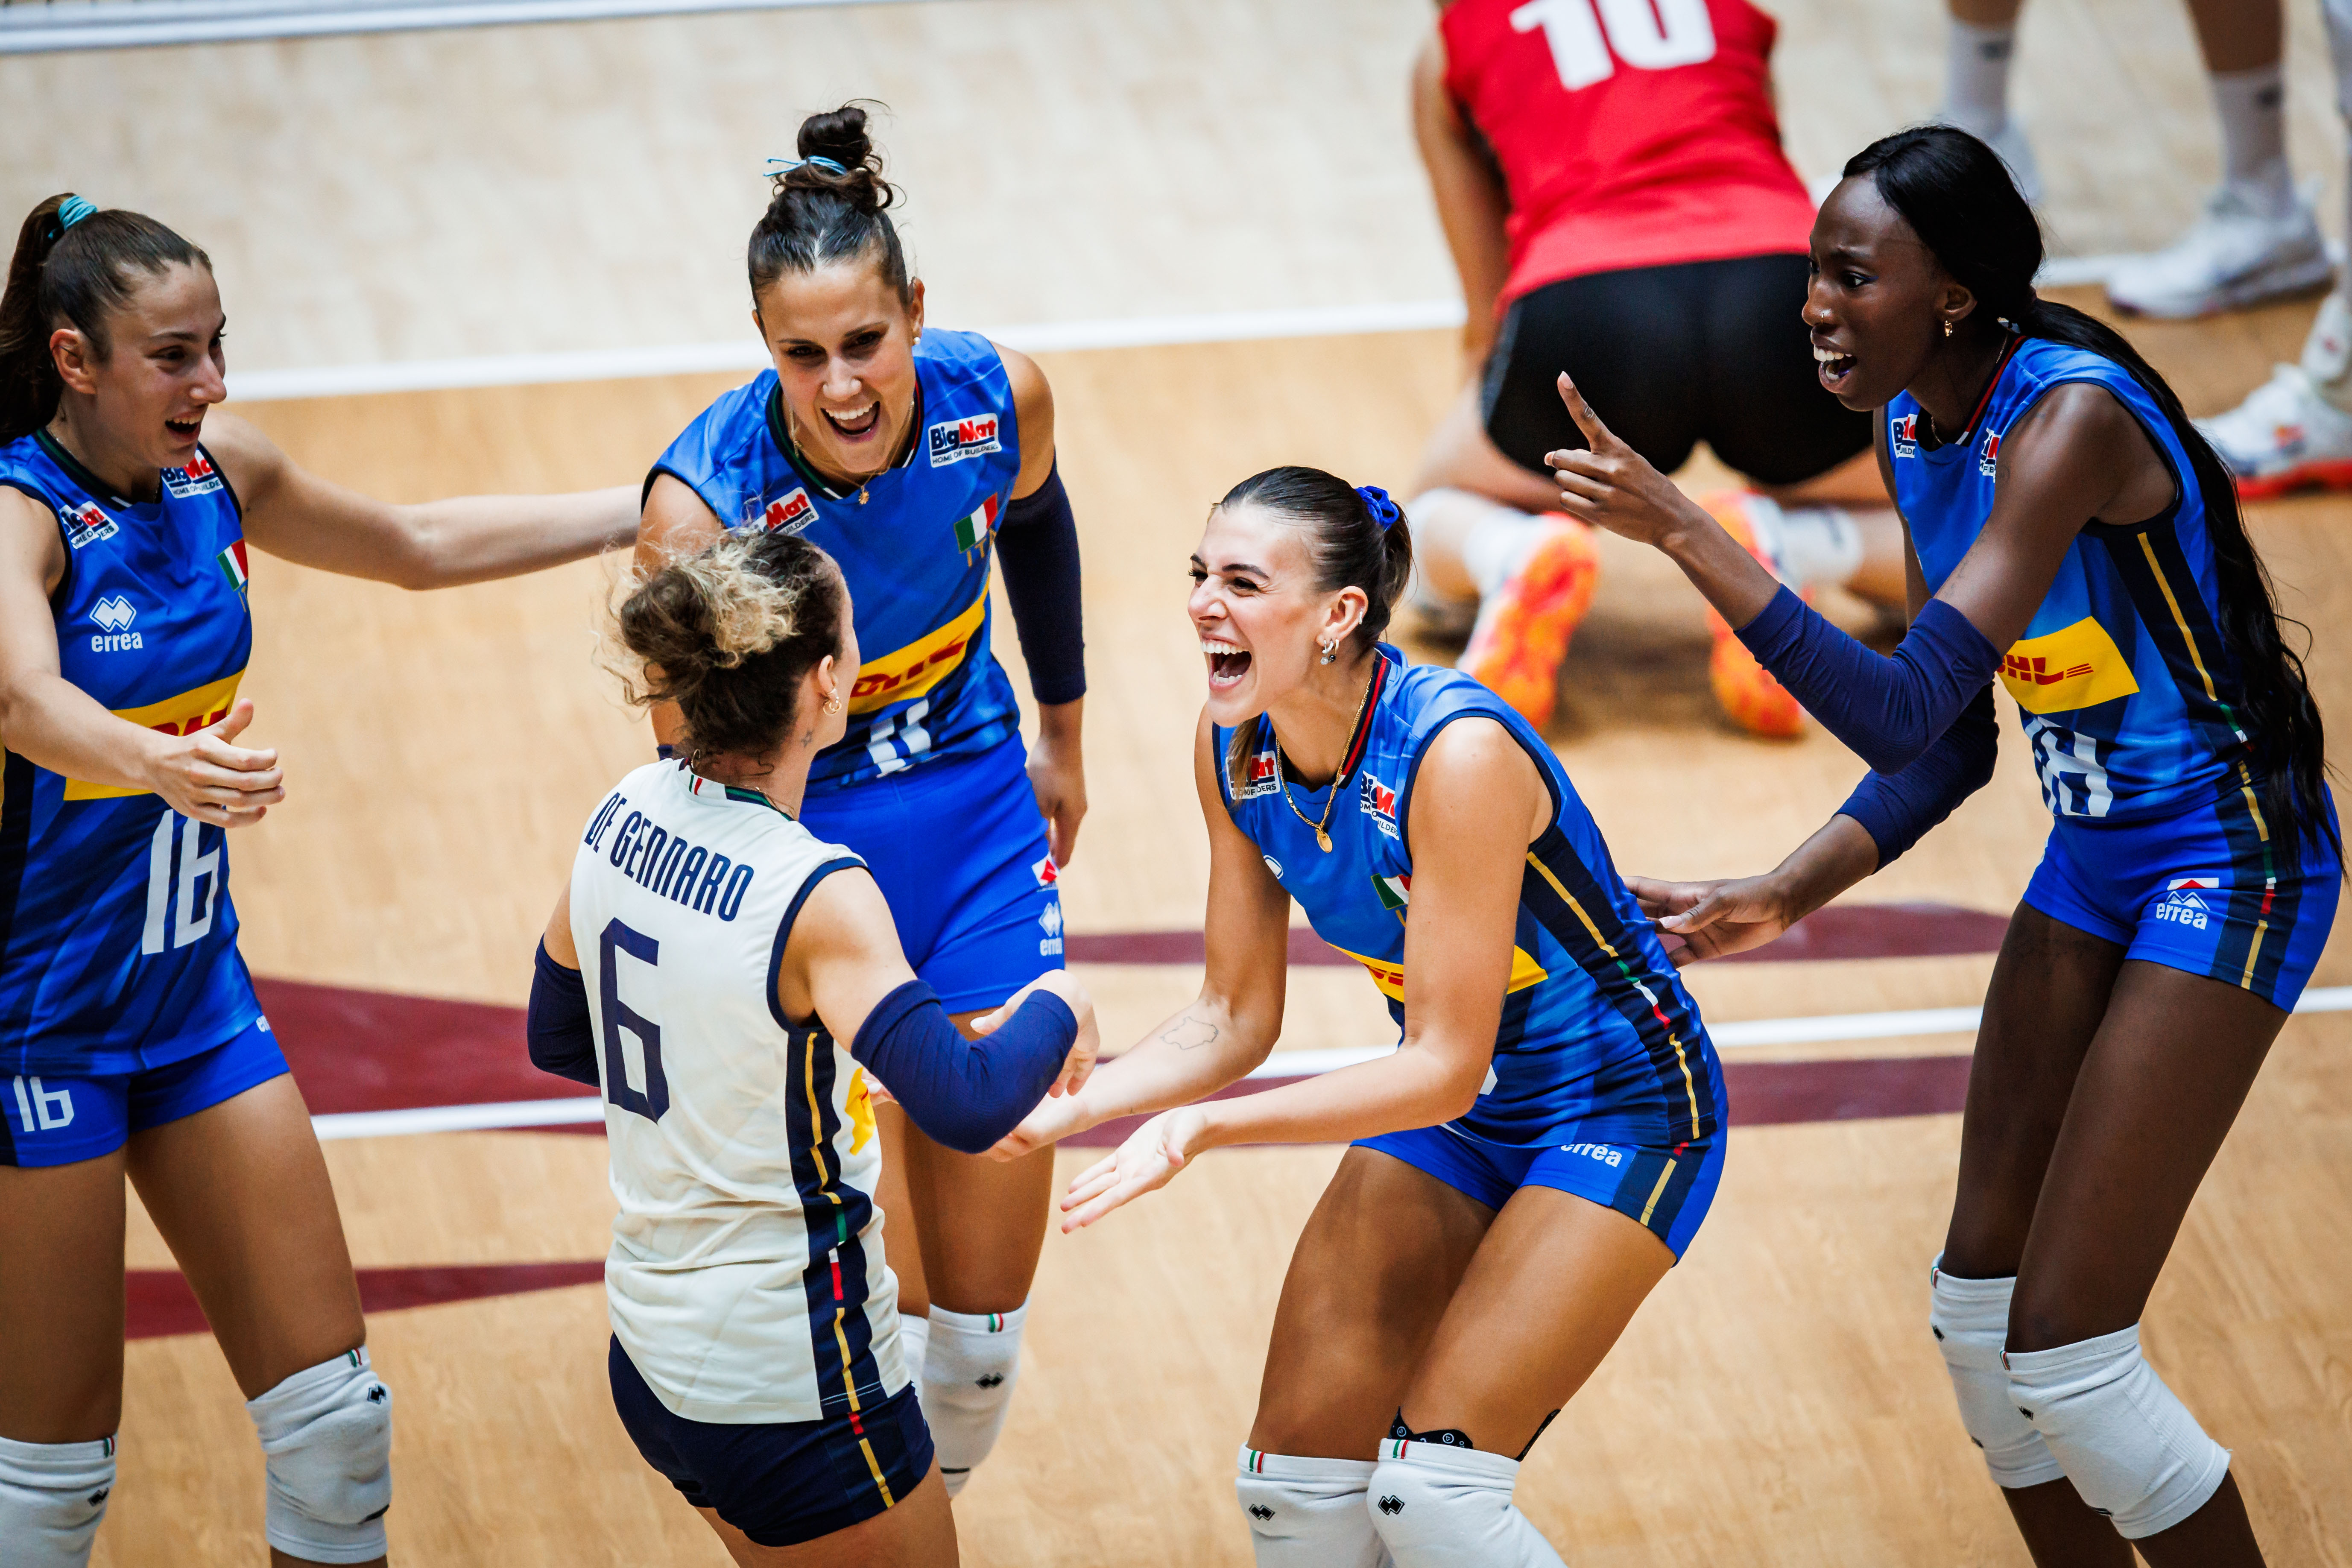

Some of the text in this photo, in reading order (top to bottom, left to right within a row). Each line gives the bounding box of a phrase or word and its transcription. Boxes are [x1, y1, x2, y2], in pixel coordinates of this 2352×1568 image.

[1509, 0, 1716, 91] 10
[930, 417, 996, 449] BigMat
[766, 493, 808, 530] Mat
[1360, 774, 1395, 817] BigM
[142, 809, 219, 955] 16
[584, 792, 754, 921] DE GENNARO
[600, 917, 670, 1125] 6
[13, 1075, 75, 1132] 16
